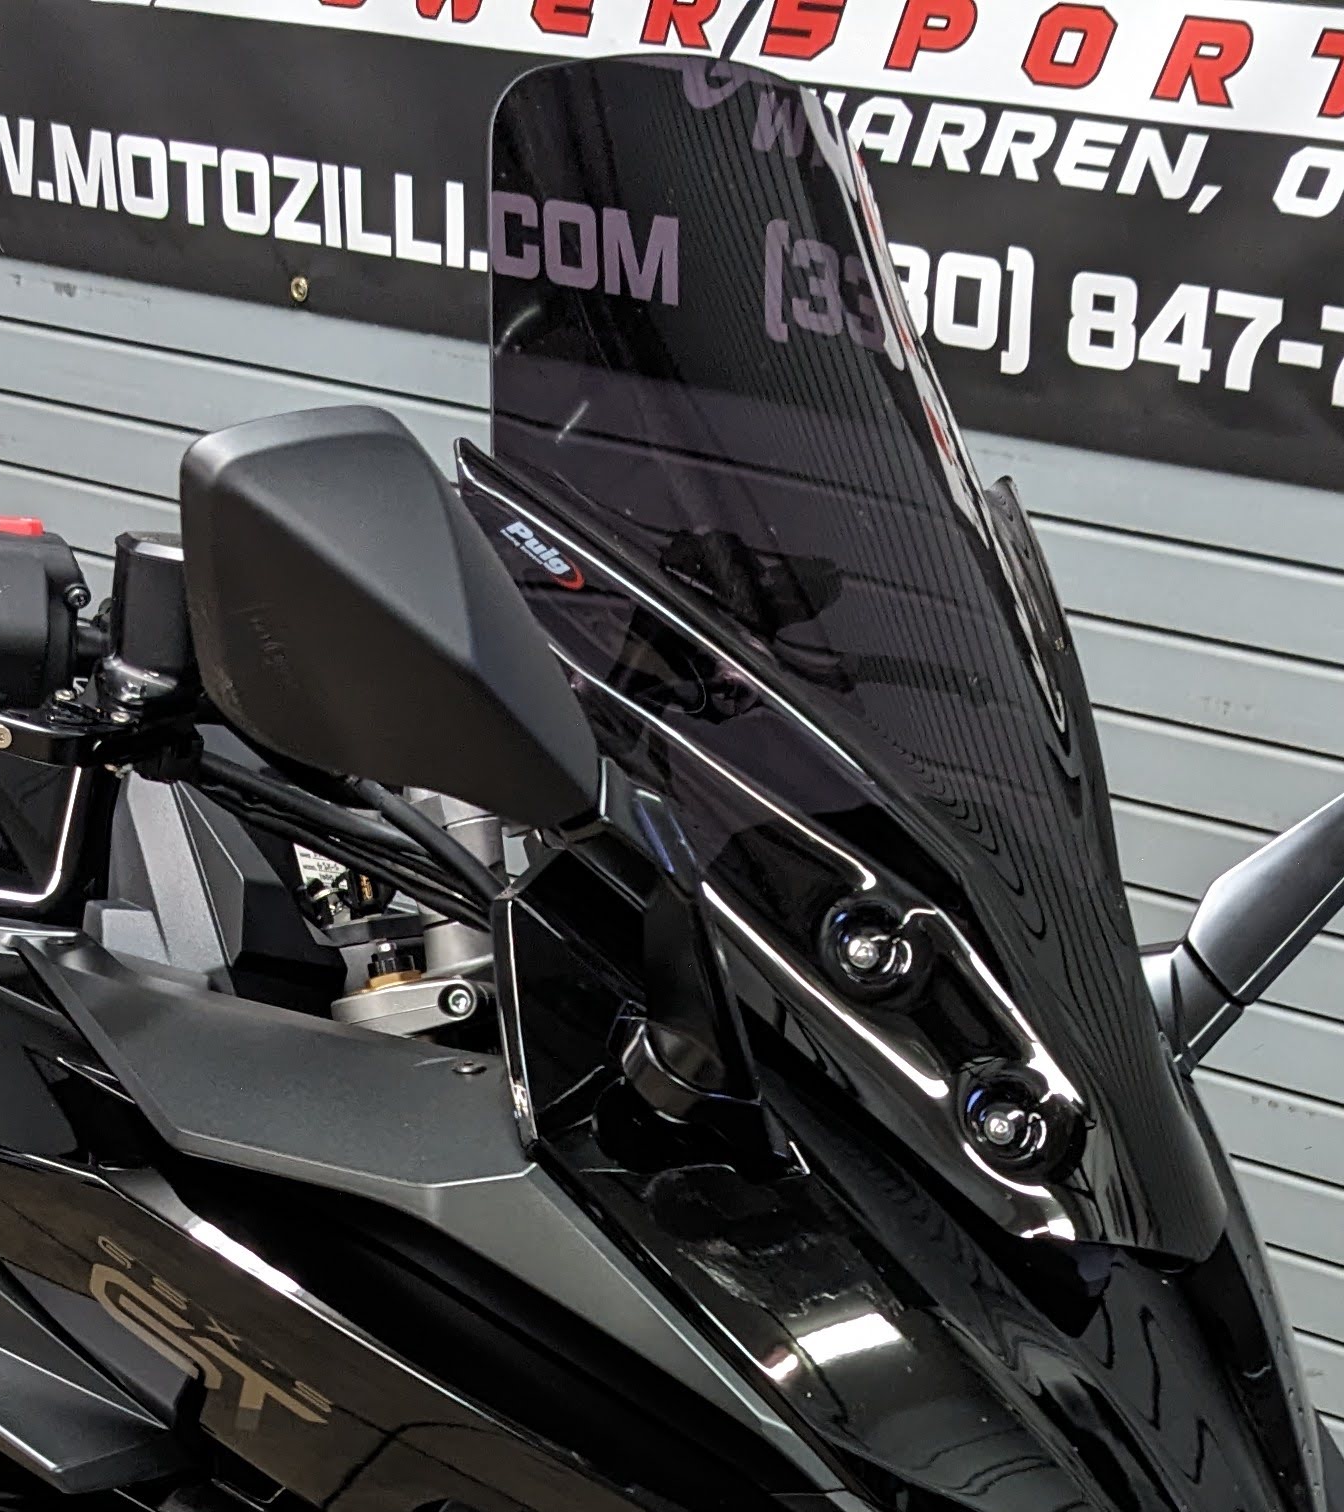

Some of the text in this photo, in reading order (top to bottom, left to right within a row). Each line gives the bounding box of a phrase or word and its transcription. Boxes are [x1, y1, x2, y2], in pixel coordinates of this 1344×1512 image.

[752, 88, 1220, 213] WARREN,
[505, 520, 571, 575] Puig
[88, 1262, 329, 1428] GT
